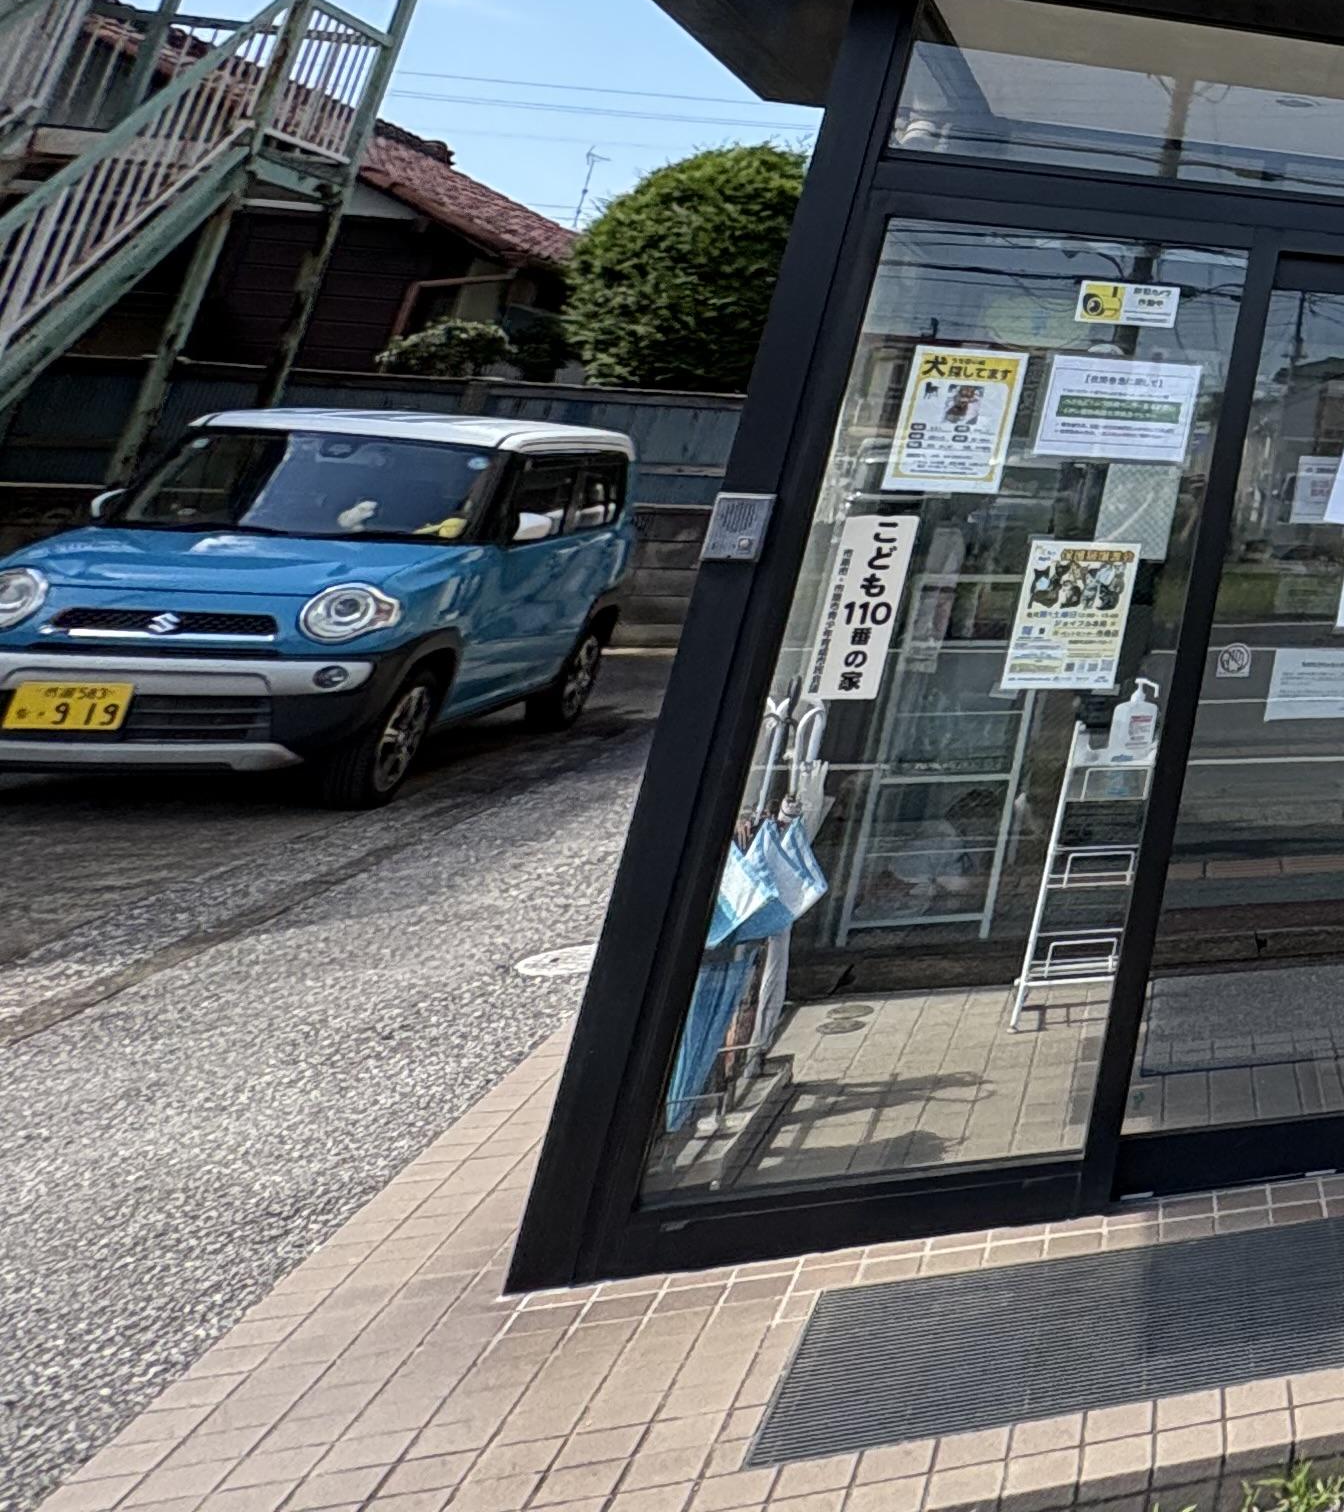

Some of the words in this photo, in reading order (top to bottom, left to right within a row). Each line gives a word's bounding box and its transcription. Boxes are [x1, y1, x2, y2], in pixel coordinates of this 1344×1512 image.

[922, 355, 948, 377] 犬
[837, 522, 899, 692] こども110番の家
